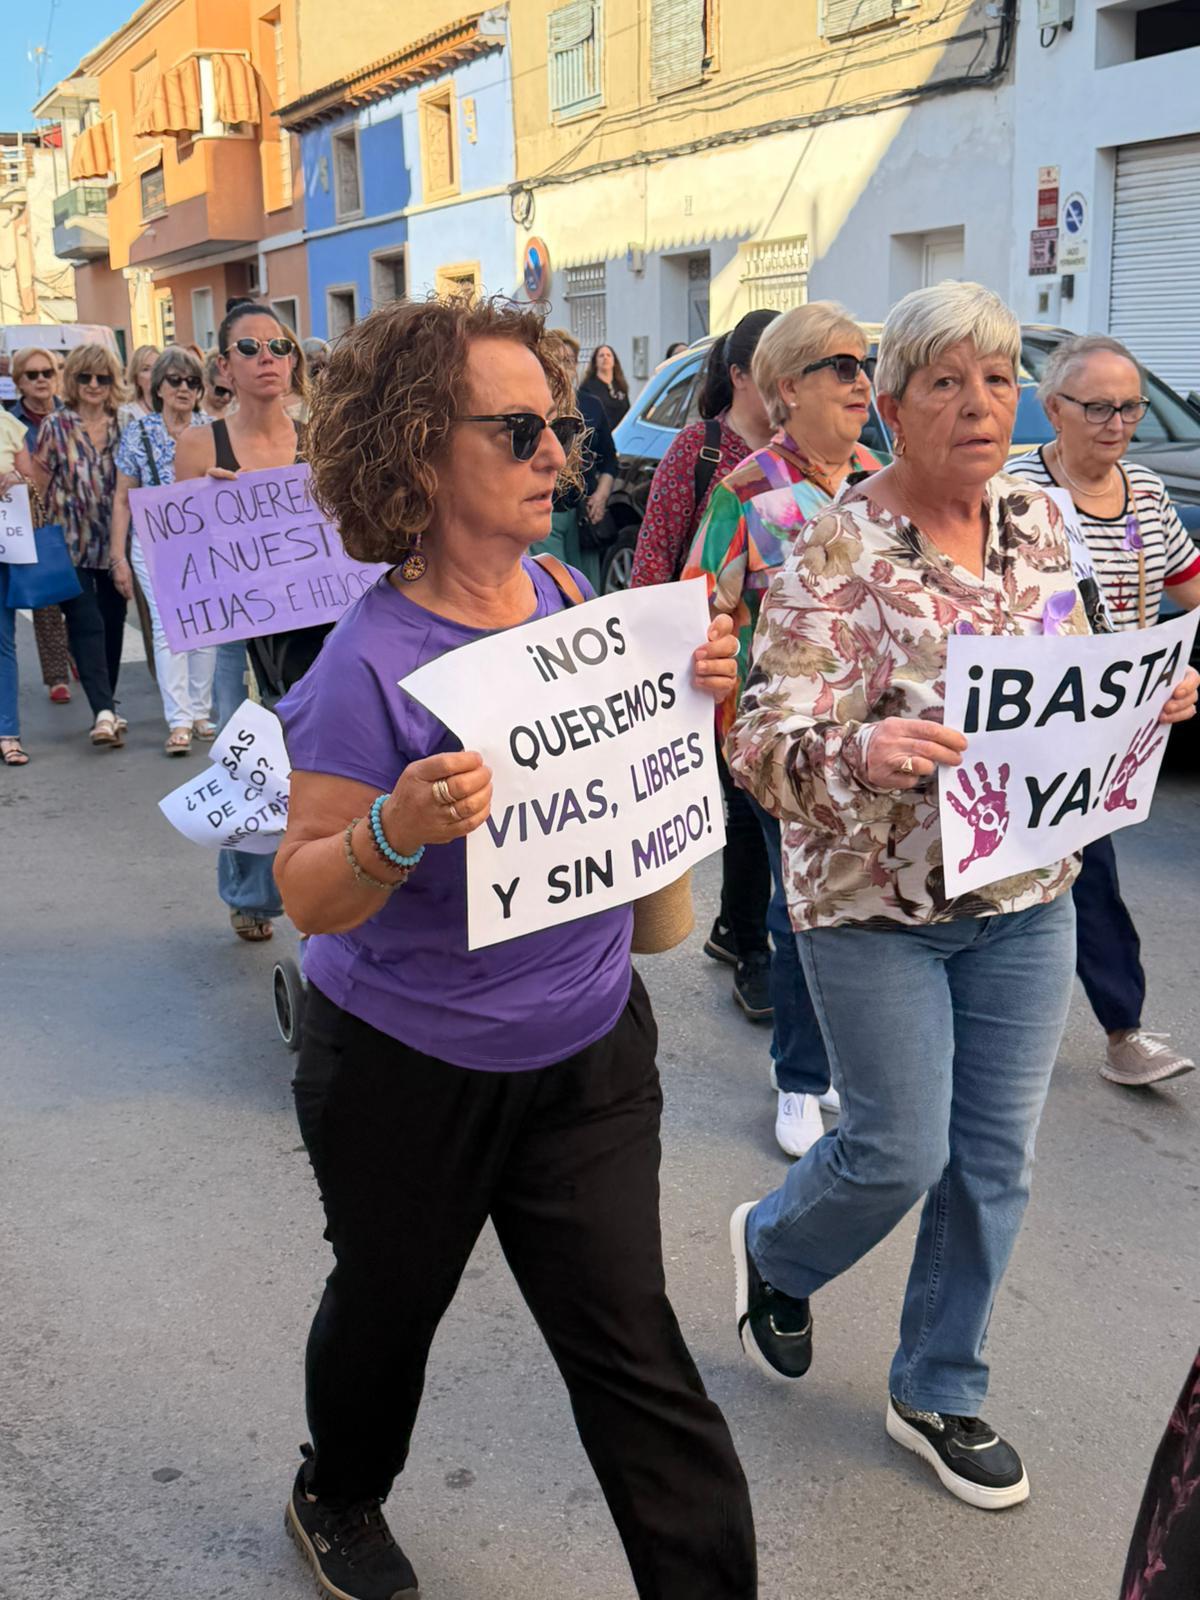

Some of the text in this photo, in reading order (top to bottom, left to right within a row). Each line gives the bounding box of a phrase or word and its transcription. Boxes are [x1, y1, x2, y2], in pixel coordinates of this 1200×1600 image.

[6, 526, 24, 537] DE
[144, 478, 313, 543] NOS QUERE
[209, 522, 334, 579] NUEST
[176, 589, 275, 638] HIJAS
[286, 583, 303, 612] E
[526, 617, 626, 682] ¡NOS
[963, 640, 1183, 733] ¡BASTA
[509, 672, 676, 770] QUEREMOS
[185, 779, 223, 812] ¿TE
[207, 800, 237, 828] DE
[486, 732, 704, 848] VIVAS, LIBRES
[1025, 753, 1117, 829] YA!
[492, 796, 712, 919] Y SIN MIEDO!
